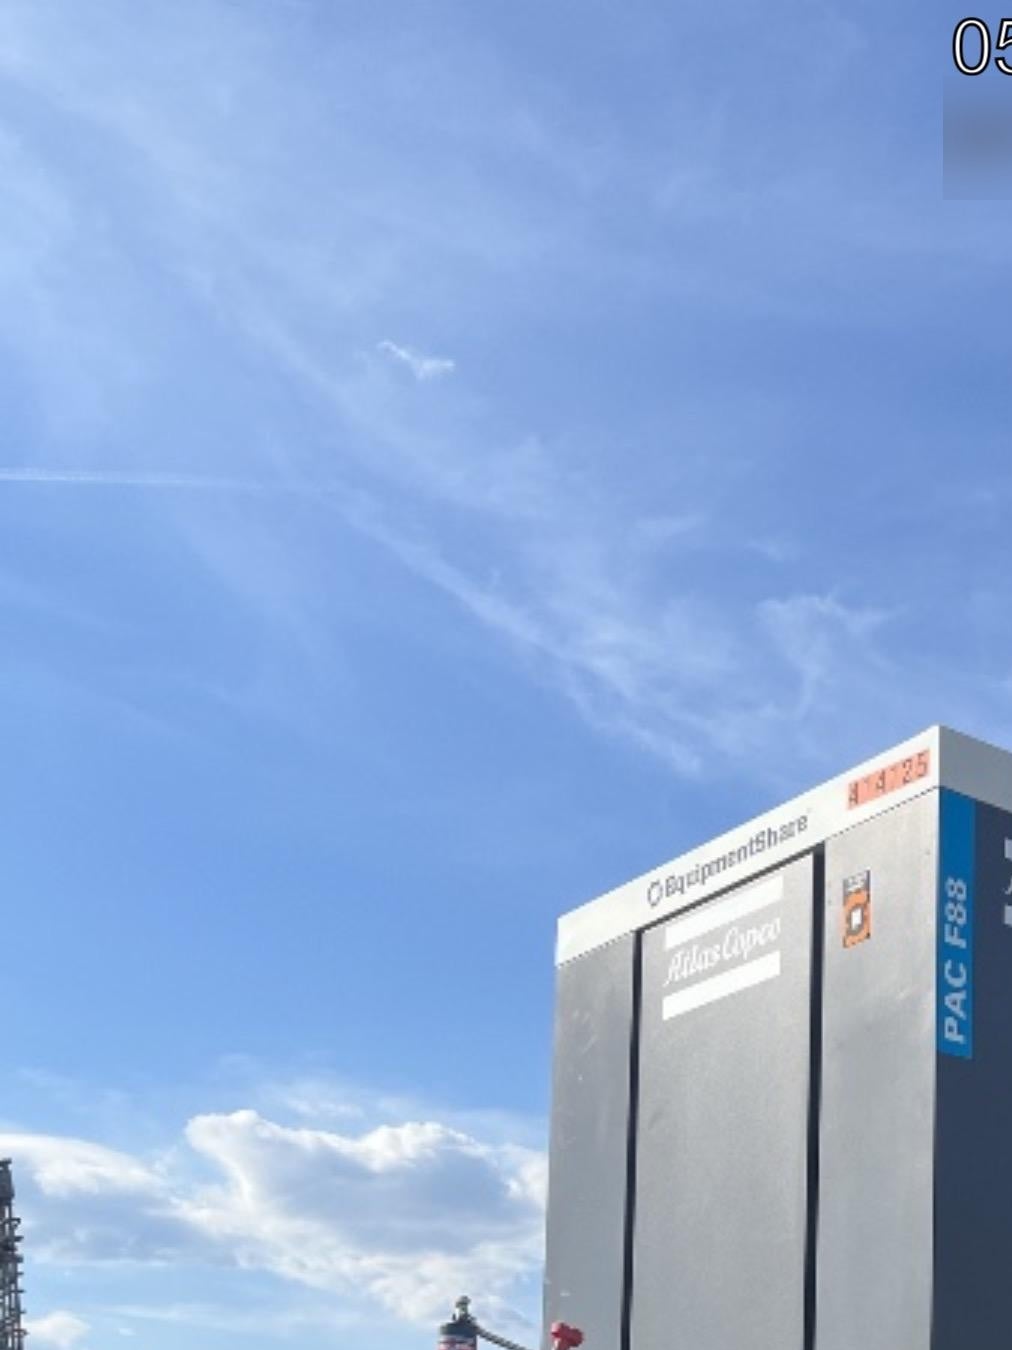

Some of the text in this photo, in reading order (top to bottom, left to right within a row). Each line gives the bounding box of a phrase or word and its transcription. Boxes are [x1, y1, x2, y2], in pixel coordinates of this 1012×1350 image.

[664, 814, 808, 898] EquipmentShare
[943, 876, 968, 1045] PAC F88
